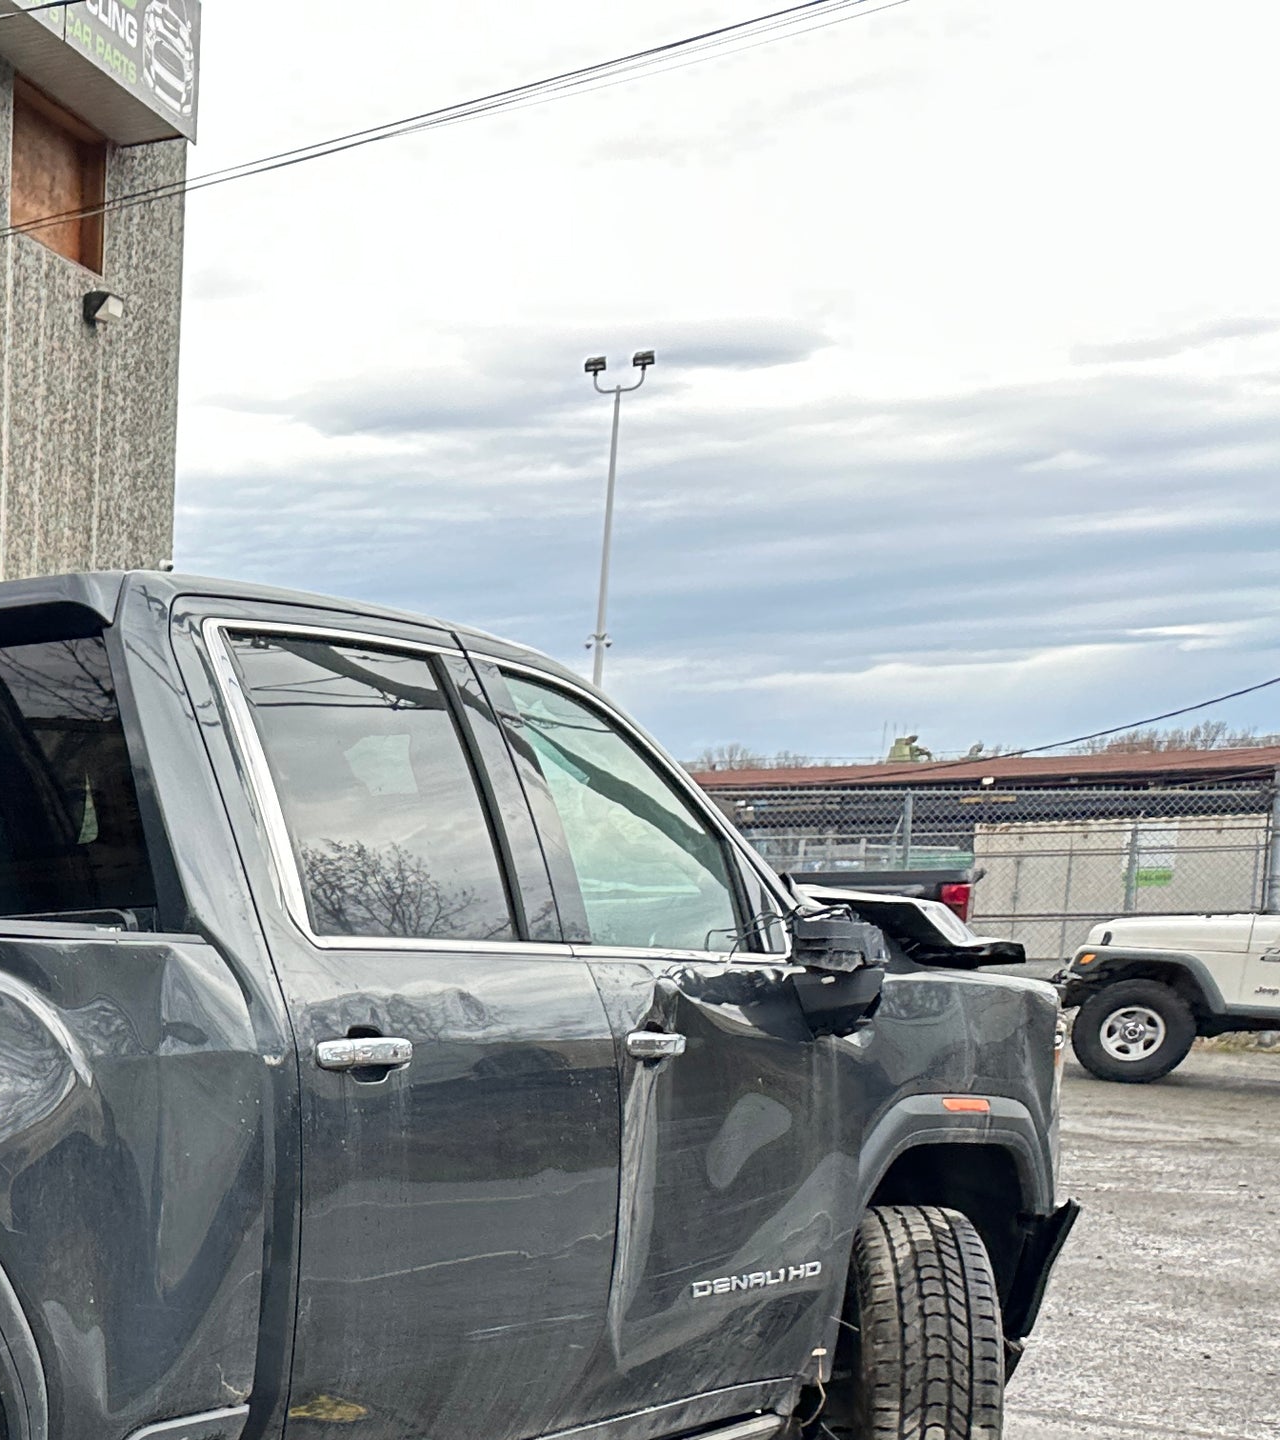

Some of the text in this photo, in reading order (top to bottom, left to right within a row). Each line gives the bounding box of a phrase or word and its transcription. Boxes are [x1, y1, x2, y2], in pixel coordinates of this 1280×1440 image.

[95, 34, 137, 84] PARTS
[691, 1260, 822, 1298] DENALI HD
